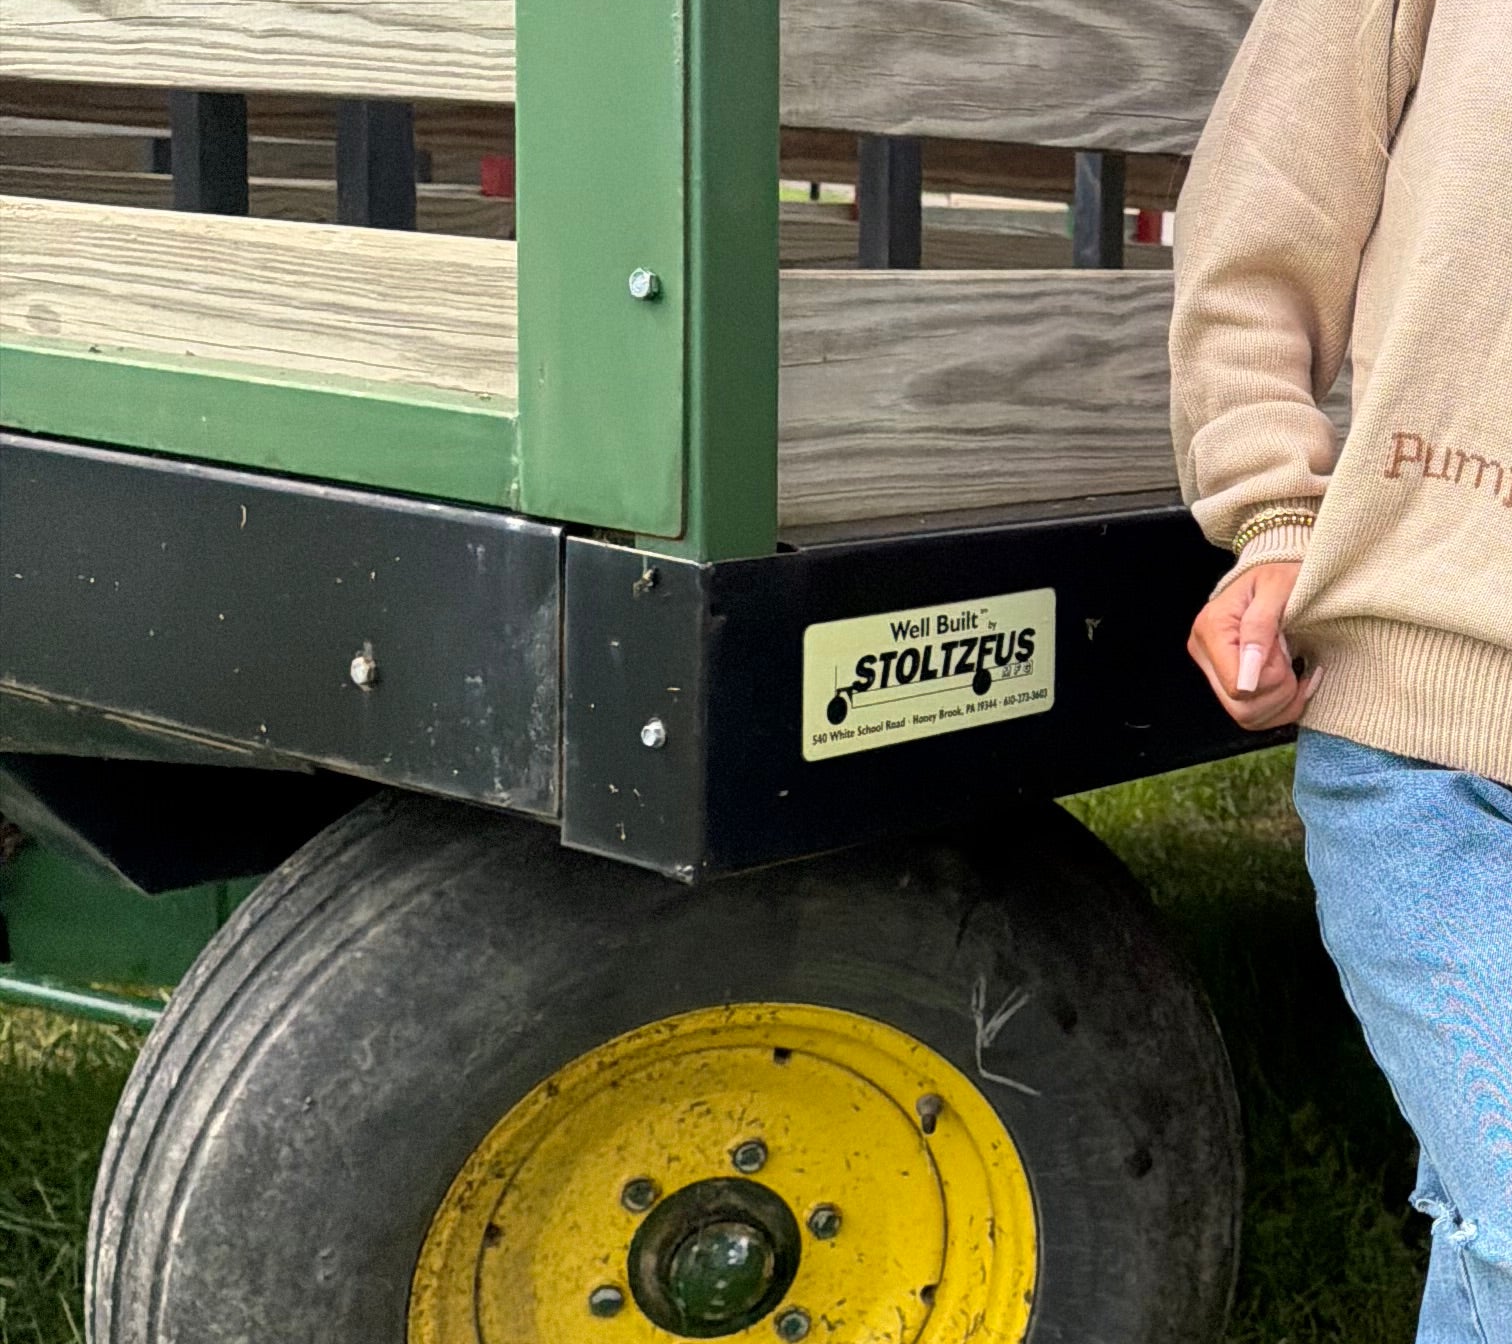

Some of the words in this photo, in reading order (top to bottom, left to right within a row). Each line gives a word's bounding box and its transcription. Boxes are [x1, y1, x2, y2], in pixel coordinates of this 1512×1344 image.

[890, 617, 930, 641] Well
[936, 611, 978, 635] Built
[988, 620, 997, 631] by
[852, 628, 1036, 691] STOLTZFUS
[812, 732, 827, 746] 540
[829, 728, 855, 741] White
[857, 721, 883, 736] School
[885, 717, 906, 731] Road
[912, 713, 937, 725] Honey
[966, 703, 975, 714] PA
